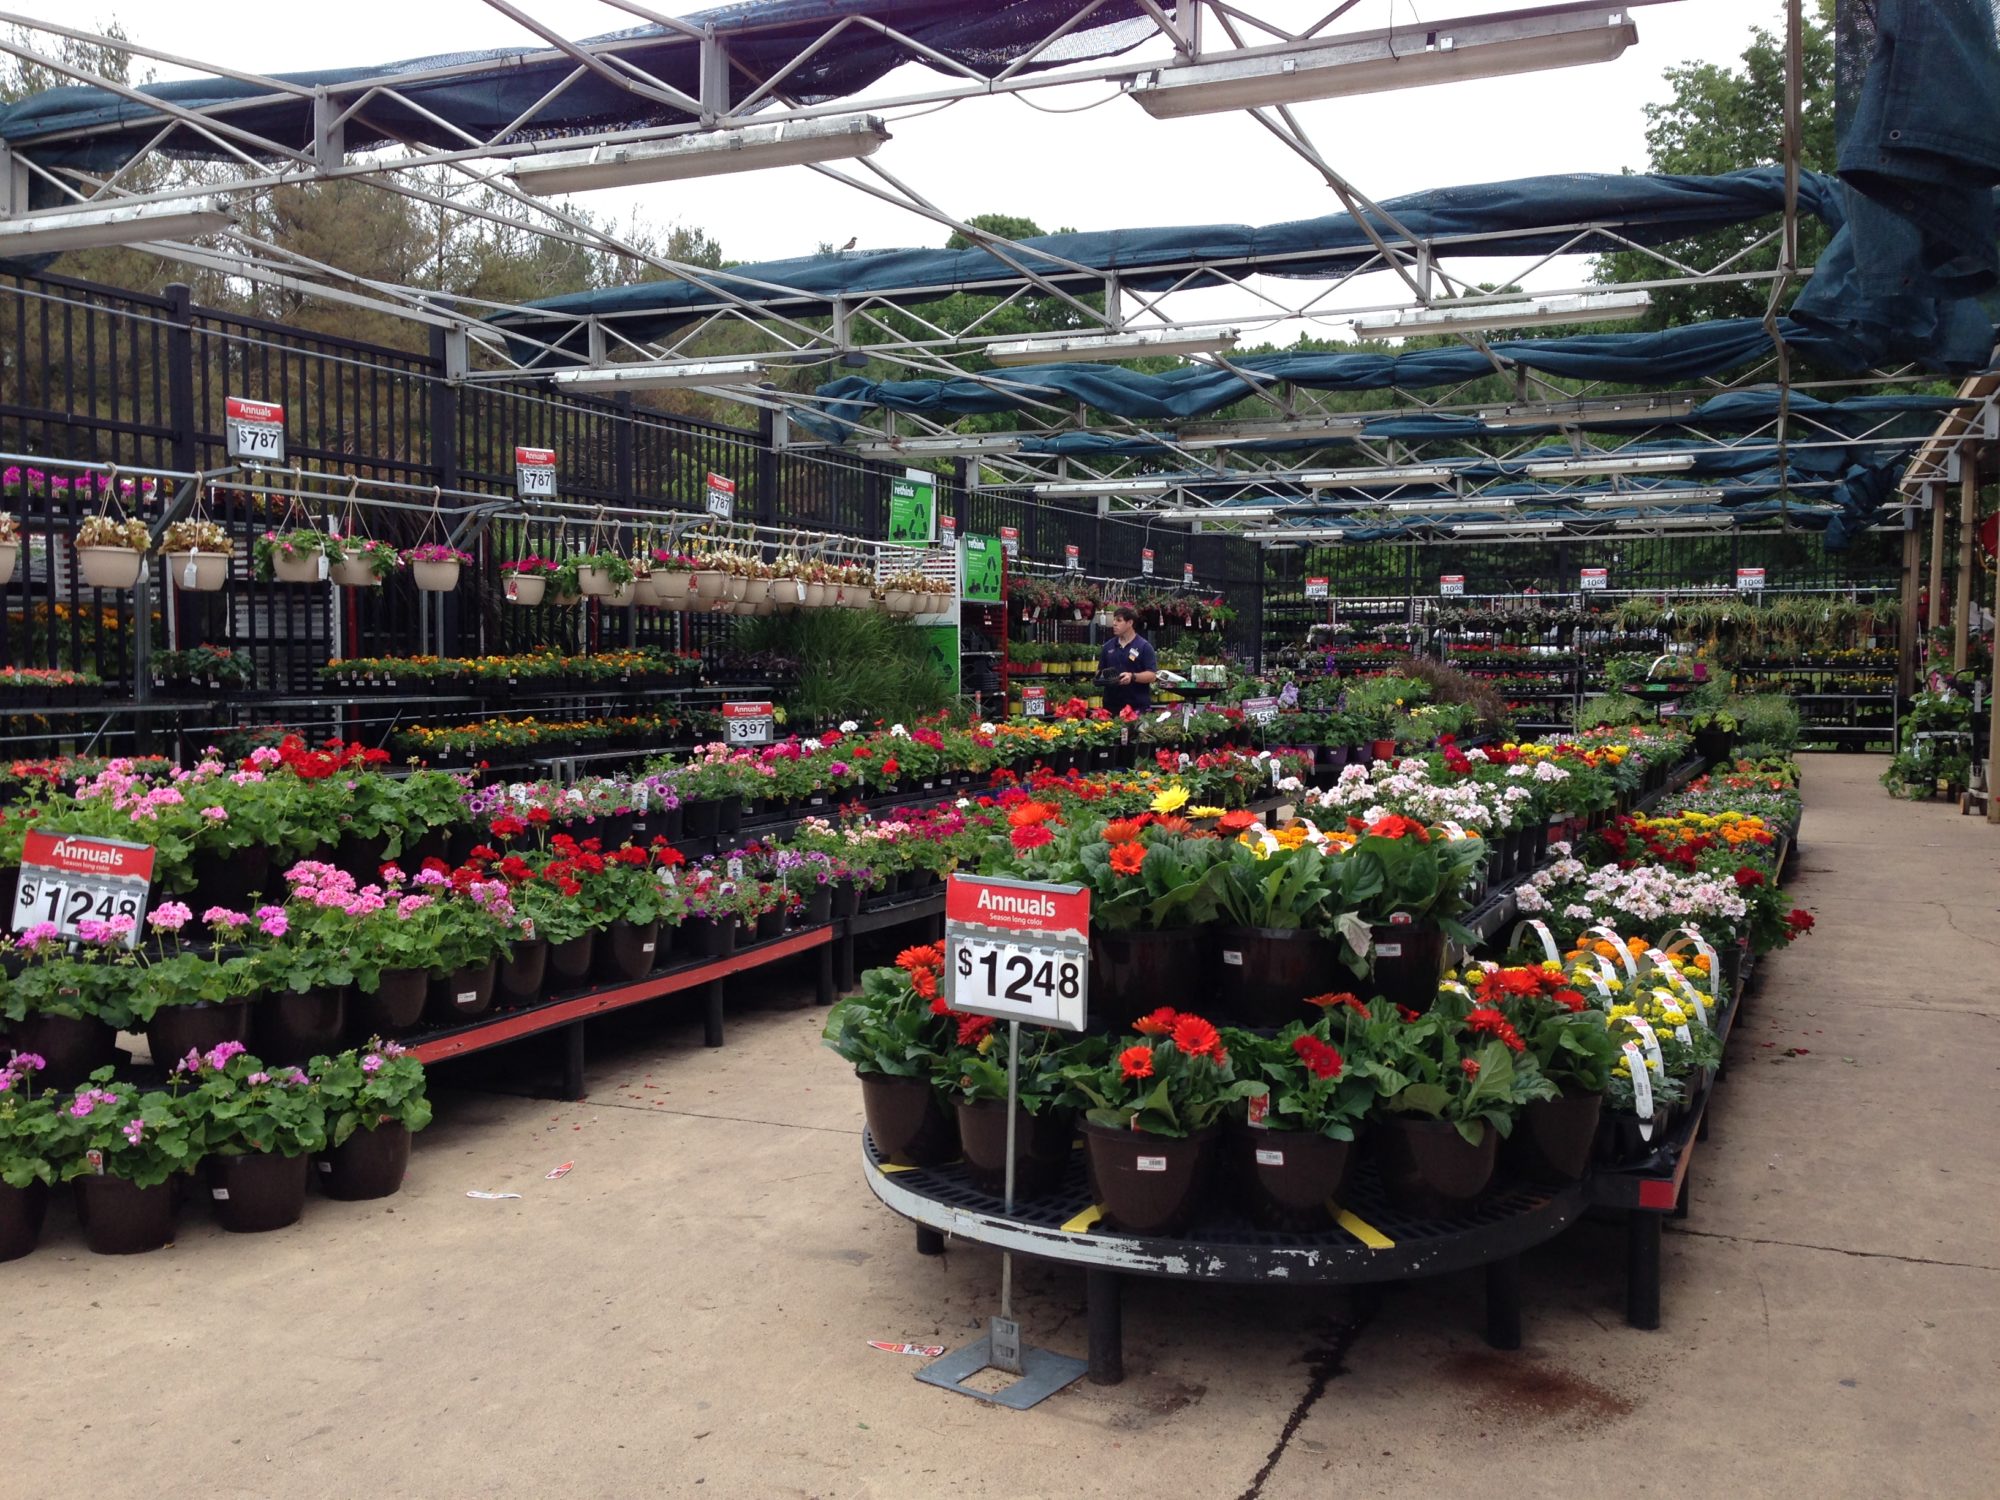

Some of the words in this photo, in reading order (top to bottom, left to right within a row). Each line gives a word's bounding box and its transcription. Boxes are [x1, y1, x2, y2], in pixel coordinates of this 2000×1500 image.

[240, 403, 271, 417] Annuals
[240, 430, 277, 450] $787
[525, 473, 550, 489] $787
[731, 723, 765, 737] $397
[52, 841, 124, 865] Annuals
[20, 883, 137, 926] $1248
[977, 889, 1056, 917] Annuals
[989, 913, 1012, 922] Season
[1012, 916, 1026, 926] long
[1027, 918, 1044, 926] color
[958, 946, 1079, 1004] $1248
